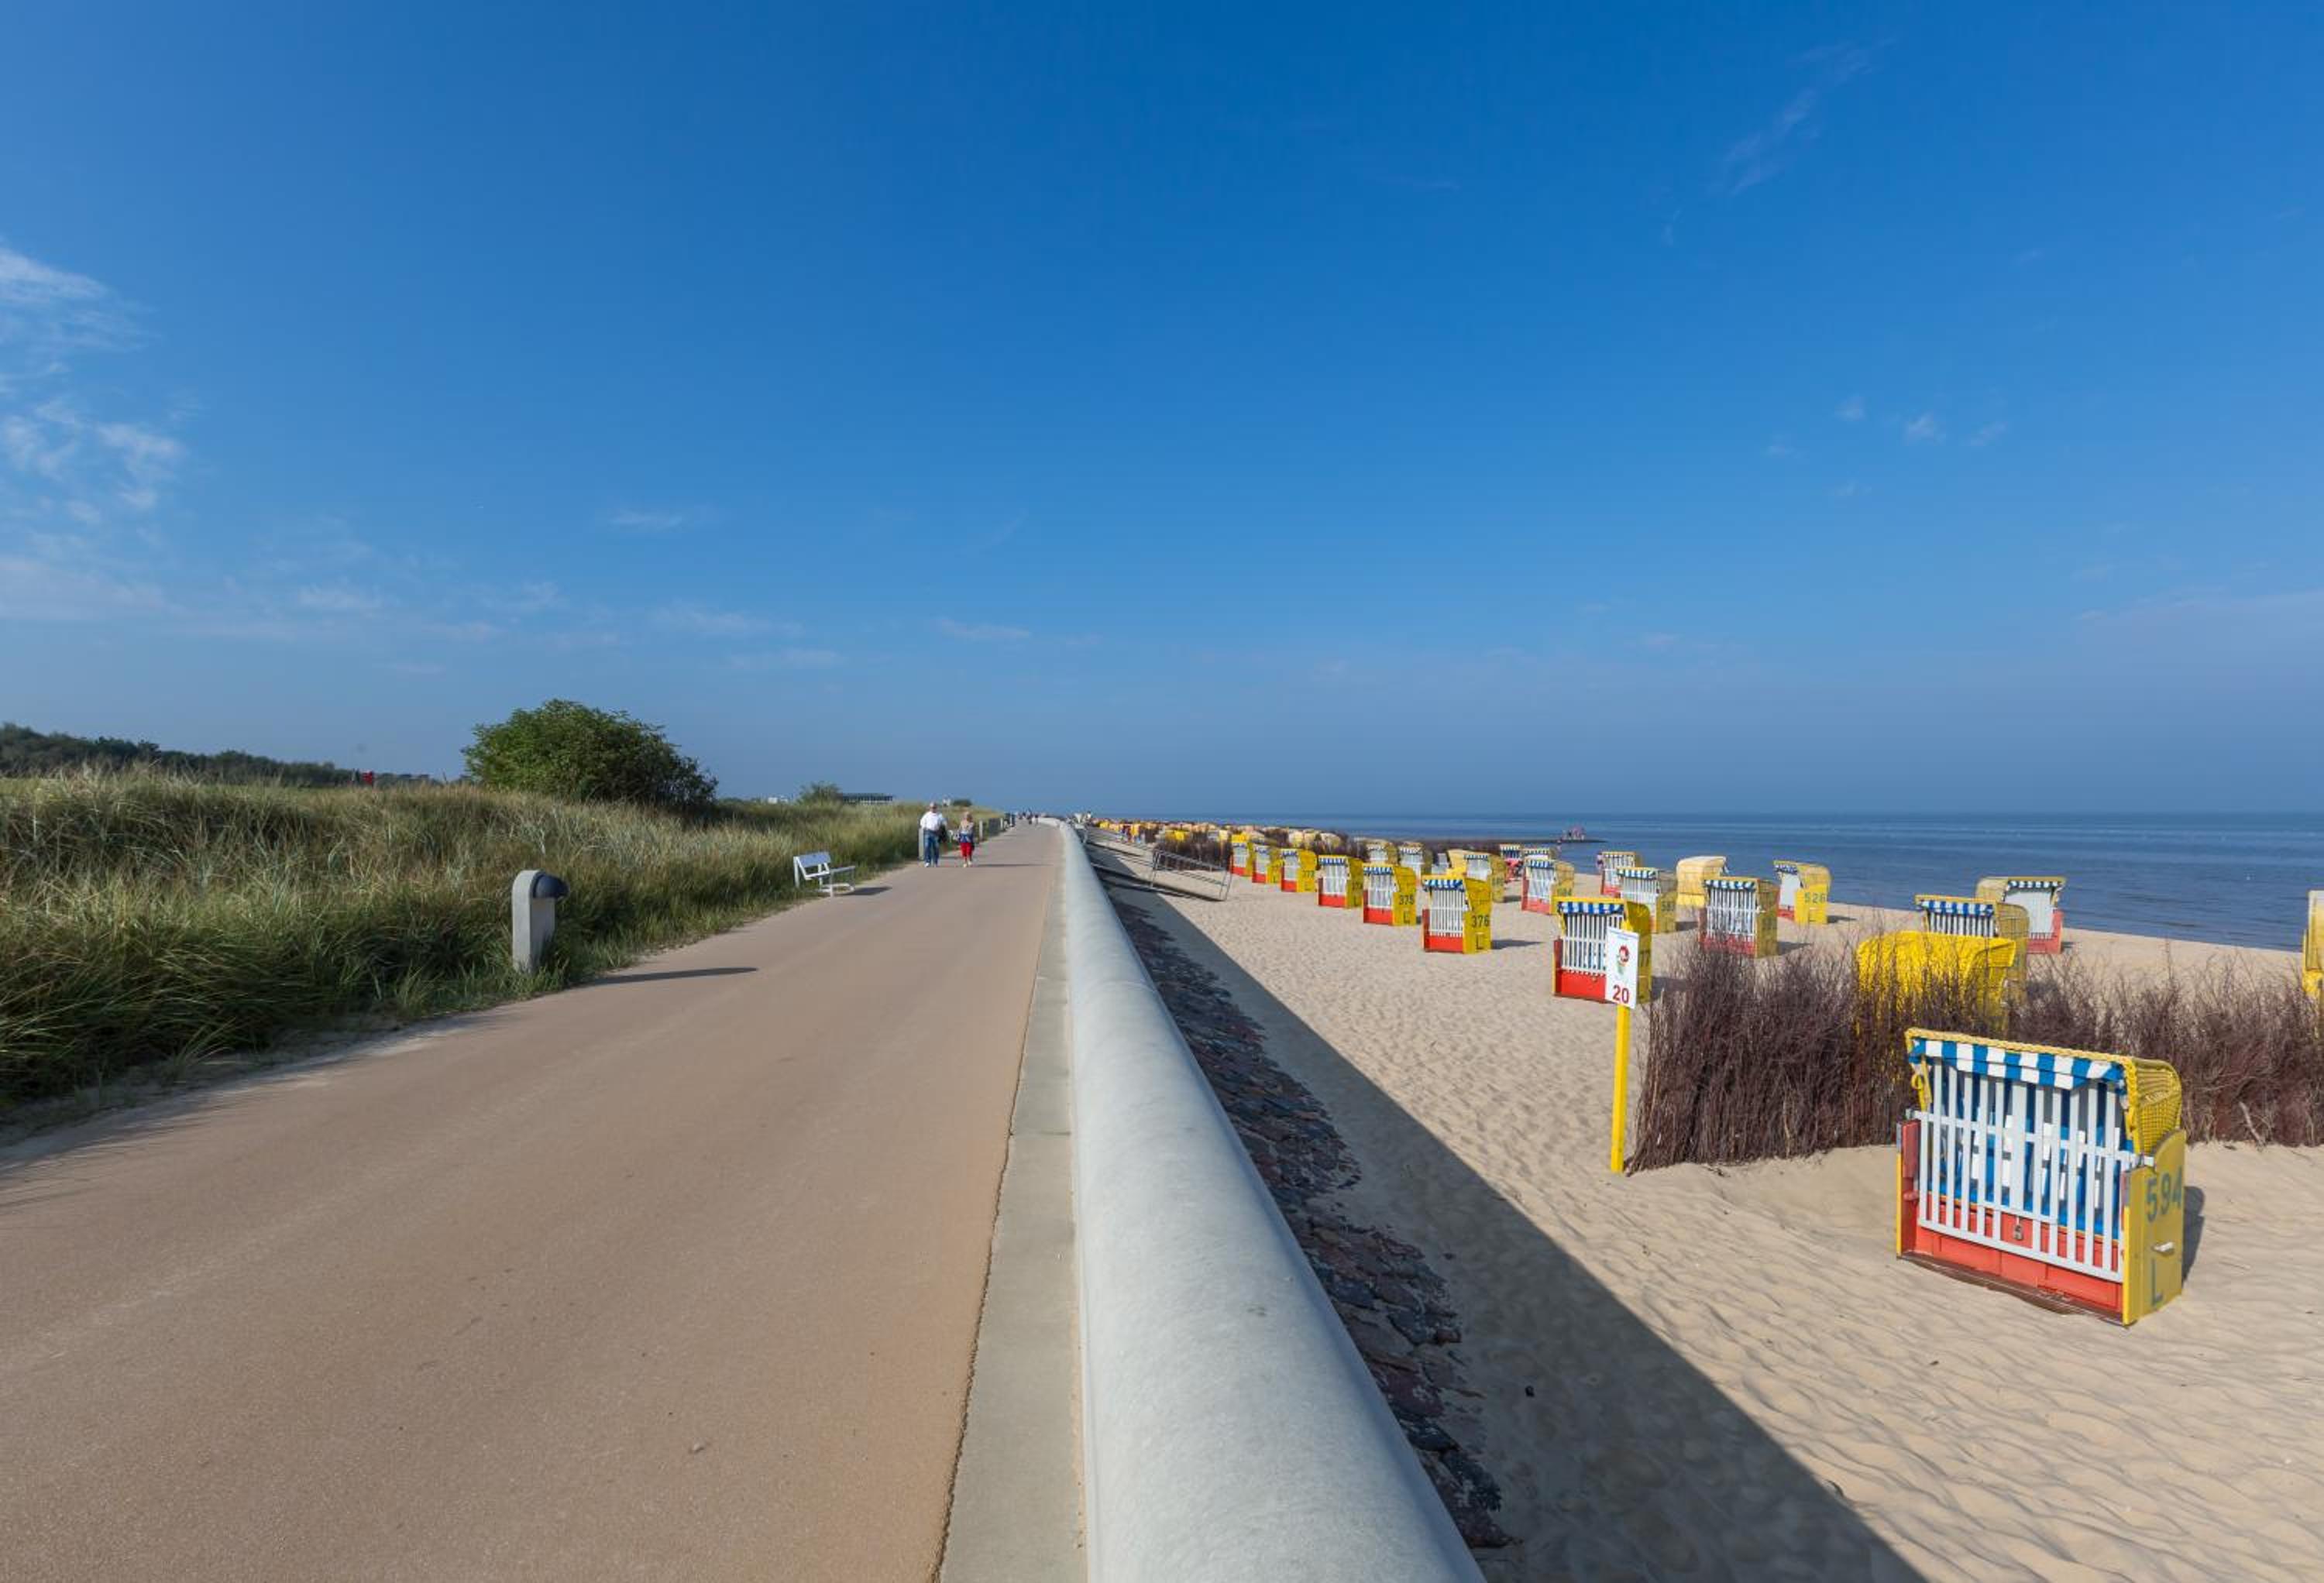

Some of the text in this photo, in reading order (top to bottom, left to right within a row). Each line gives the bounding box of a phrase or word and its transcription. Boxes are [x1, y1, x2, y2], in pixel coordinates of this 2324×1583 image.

[1804, 891, 1826, 904] 526
[1471, 915, 1489, 928] 376
[1476, 936, 1484, 949] L
[1612, 984, 1630, 1004] 20
[2146, 1166, 2183, 1222] 594
[2150, 1259, 2164, 1307] L
